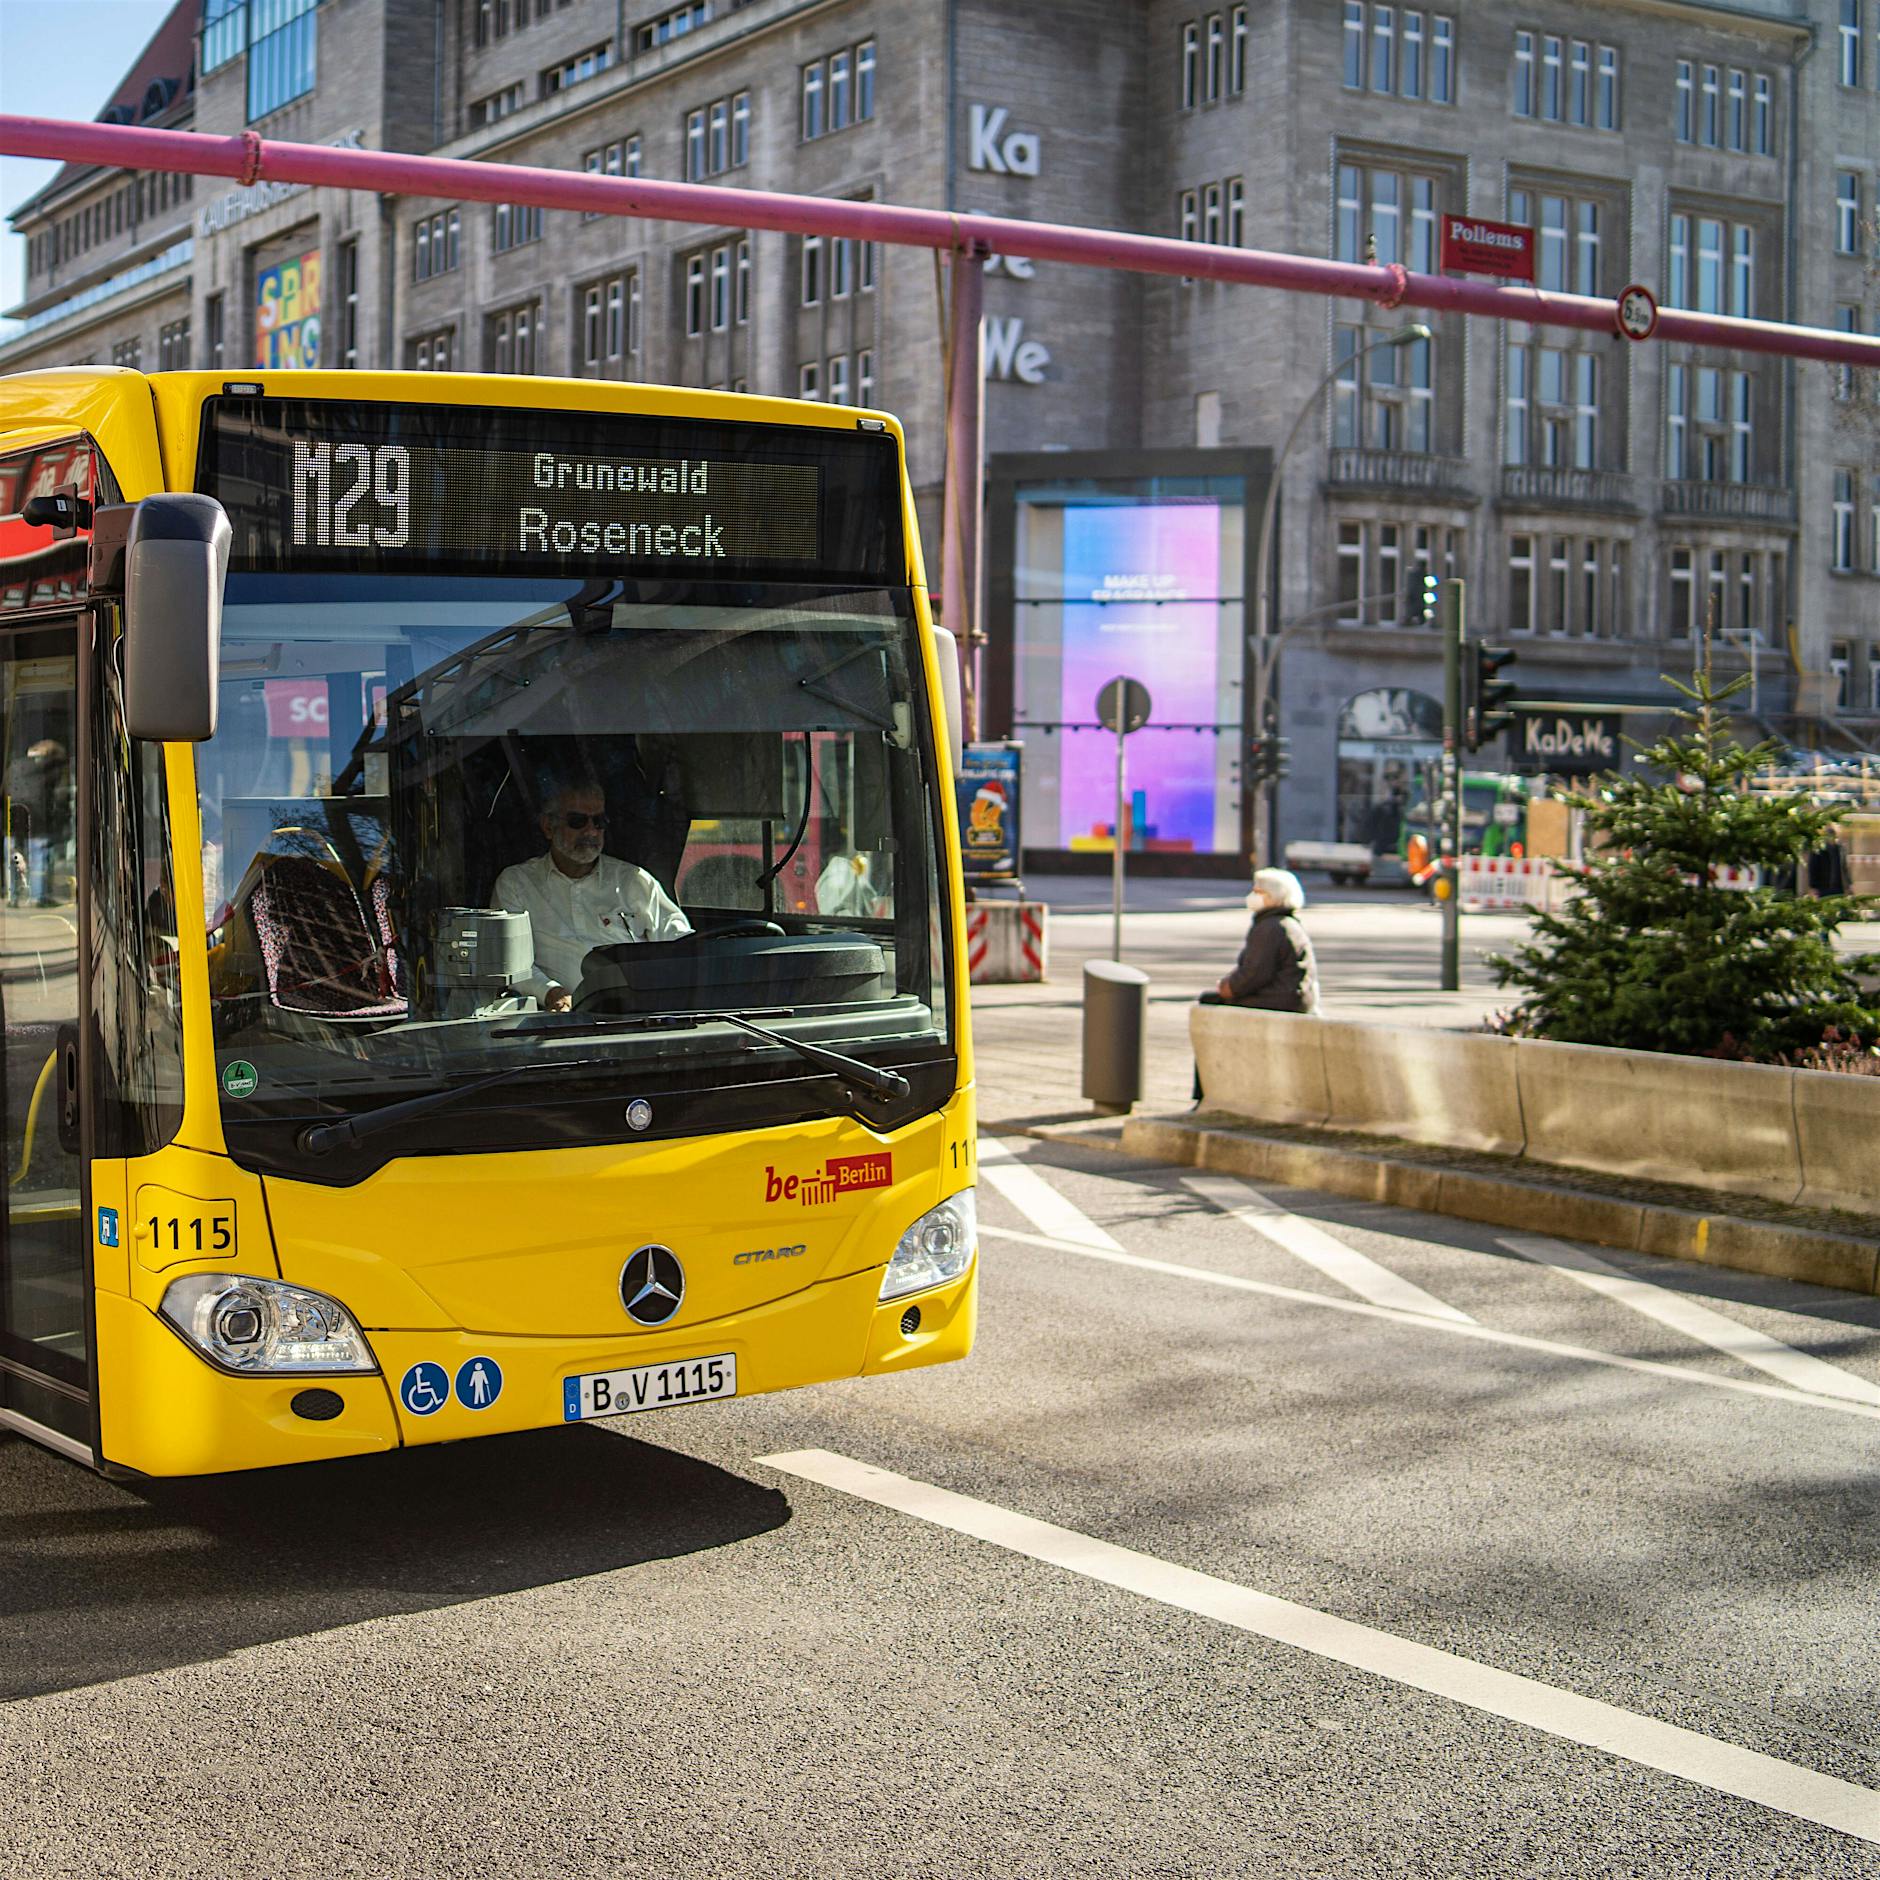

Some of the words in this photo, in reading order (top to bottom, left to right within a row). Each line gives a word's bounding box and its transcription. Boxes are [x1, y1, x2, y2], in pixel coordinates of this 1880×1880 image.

[969, 104, 1040, 177] Ka
[1450, 221, 1525, 249] Pollems
[534, 453, 707, 494] Grunewald
[294, 441, 409, 547] M29
[520, 507, 726, 557] Roseneck
[1526, 717, 1613, 757] KaDeWe
[235, 1063, 245, 1079] 4
[765, 1166, 799, 1202] be
[839, 1164, 887, 1186] Berlin
[149, 1216, 231, 1250] 1115
[733, 1244, 807, 1266] CITARO
[569, 1404, 577, 1414] D
[657, 1360, 724, 1402] 1115
